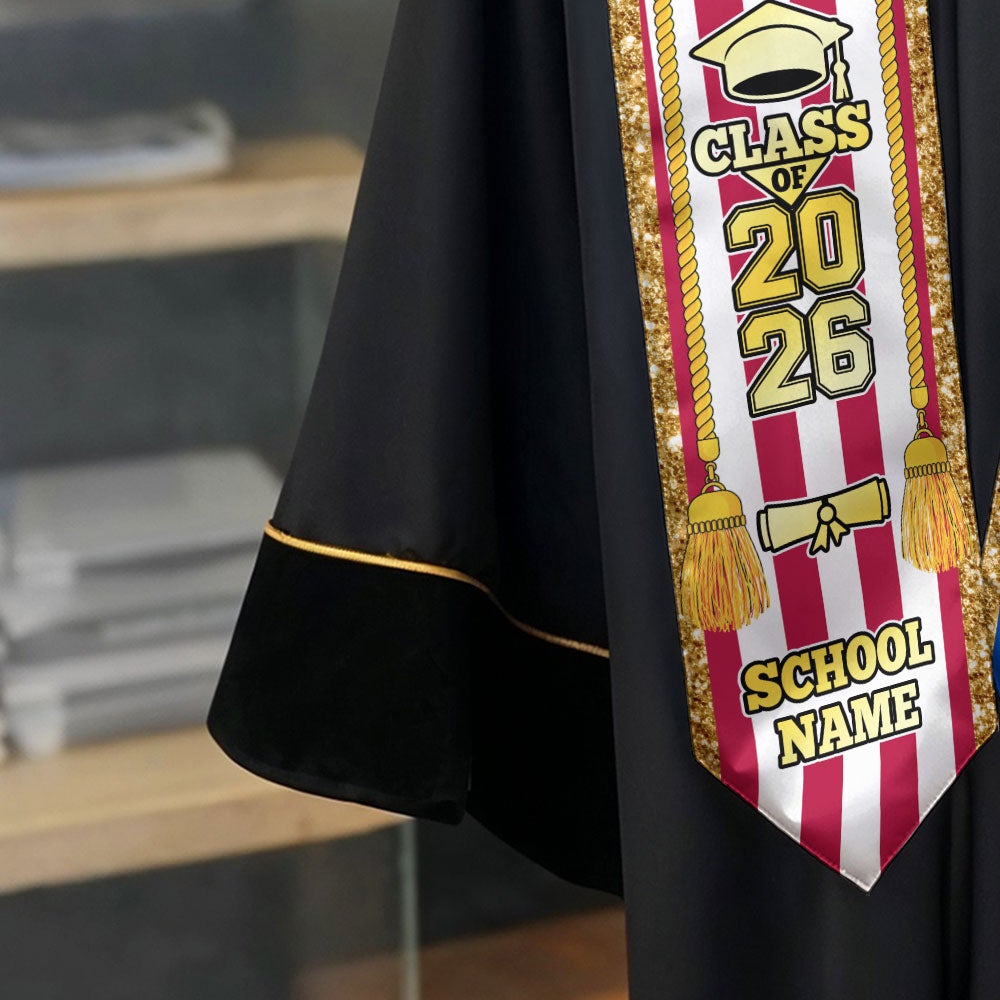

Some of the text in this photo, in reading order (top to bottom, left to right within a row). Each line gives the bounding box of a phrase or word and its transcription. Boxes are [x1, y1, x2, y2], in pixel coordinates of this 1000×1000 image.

[692, 100, 872, 175] CLASS
[771, 165, 808, 192] OF
[723, 187, 865, 311] 20
[738, 290, 876, 417] 26
[740, 617, 936, 714] SCHOOL
[773, 679, 923, 769] NAME
